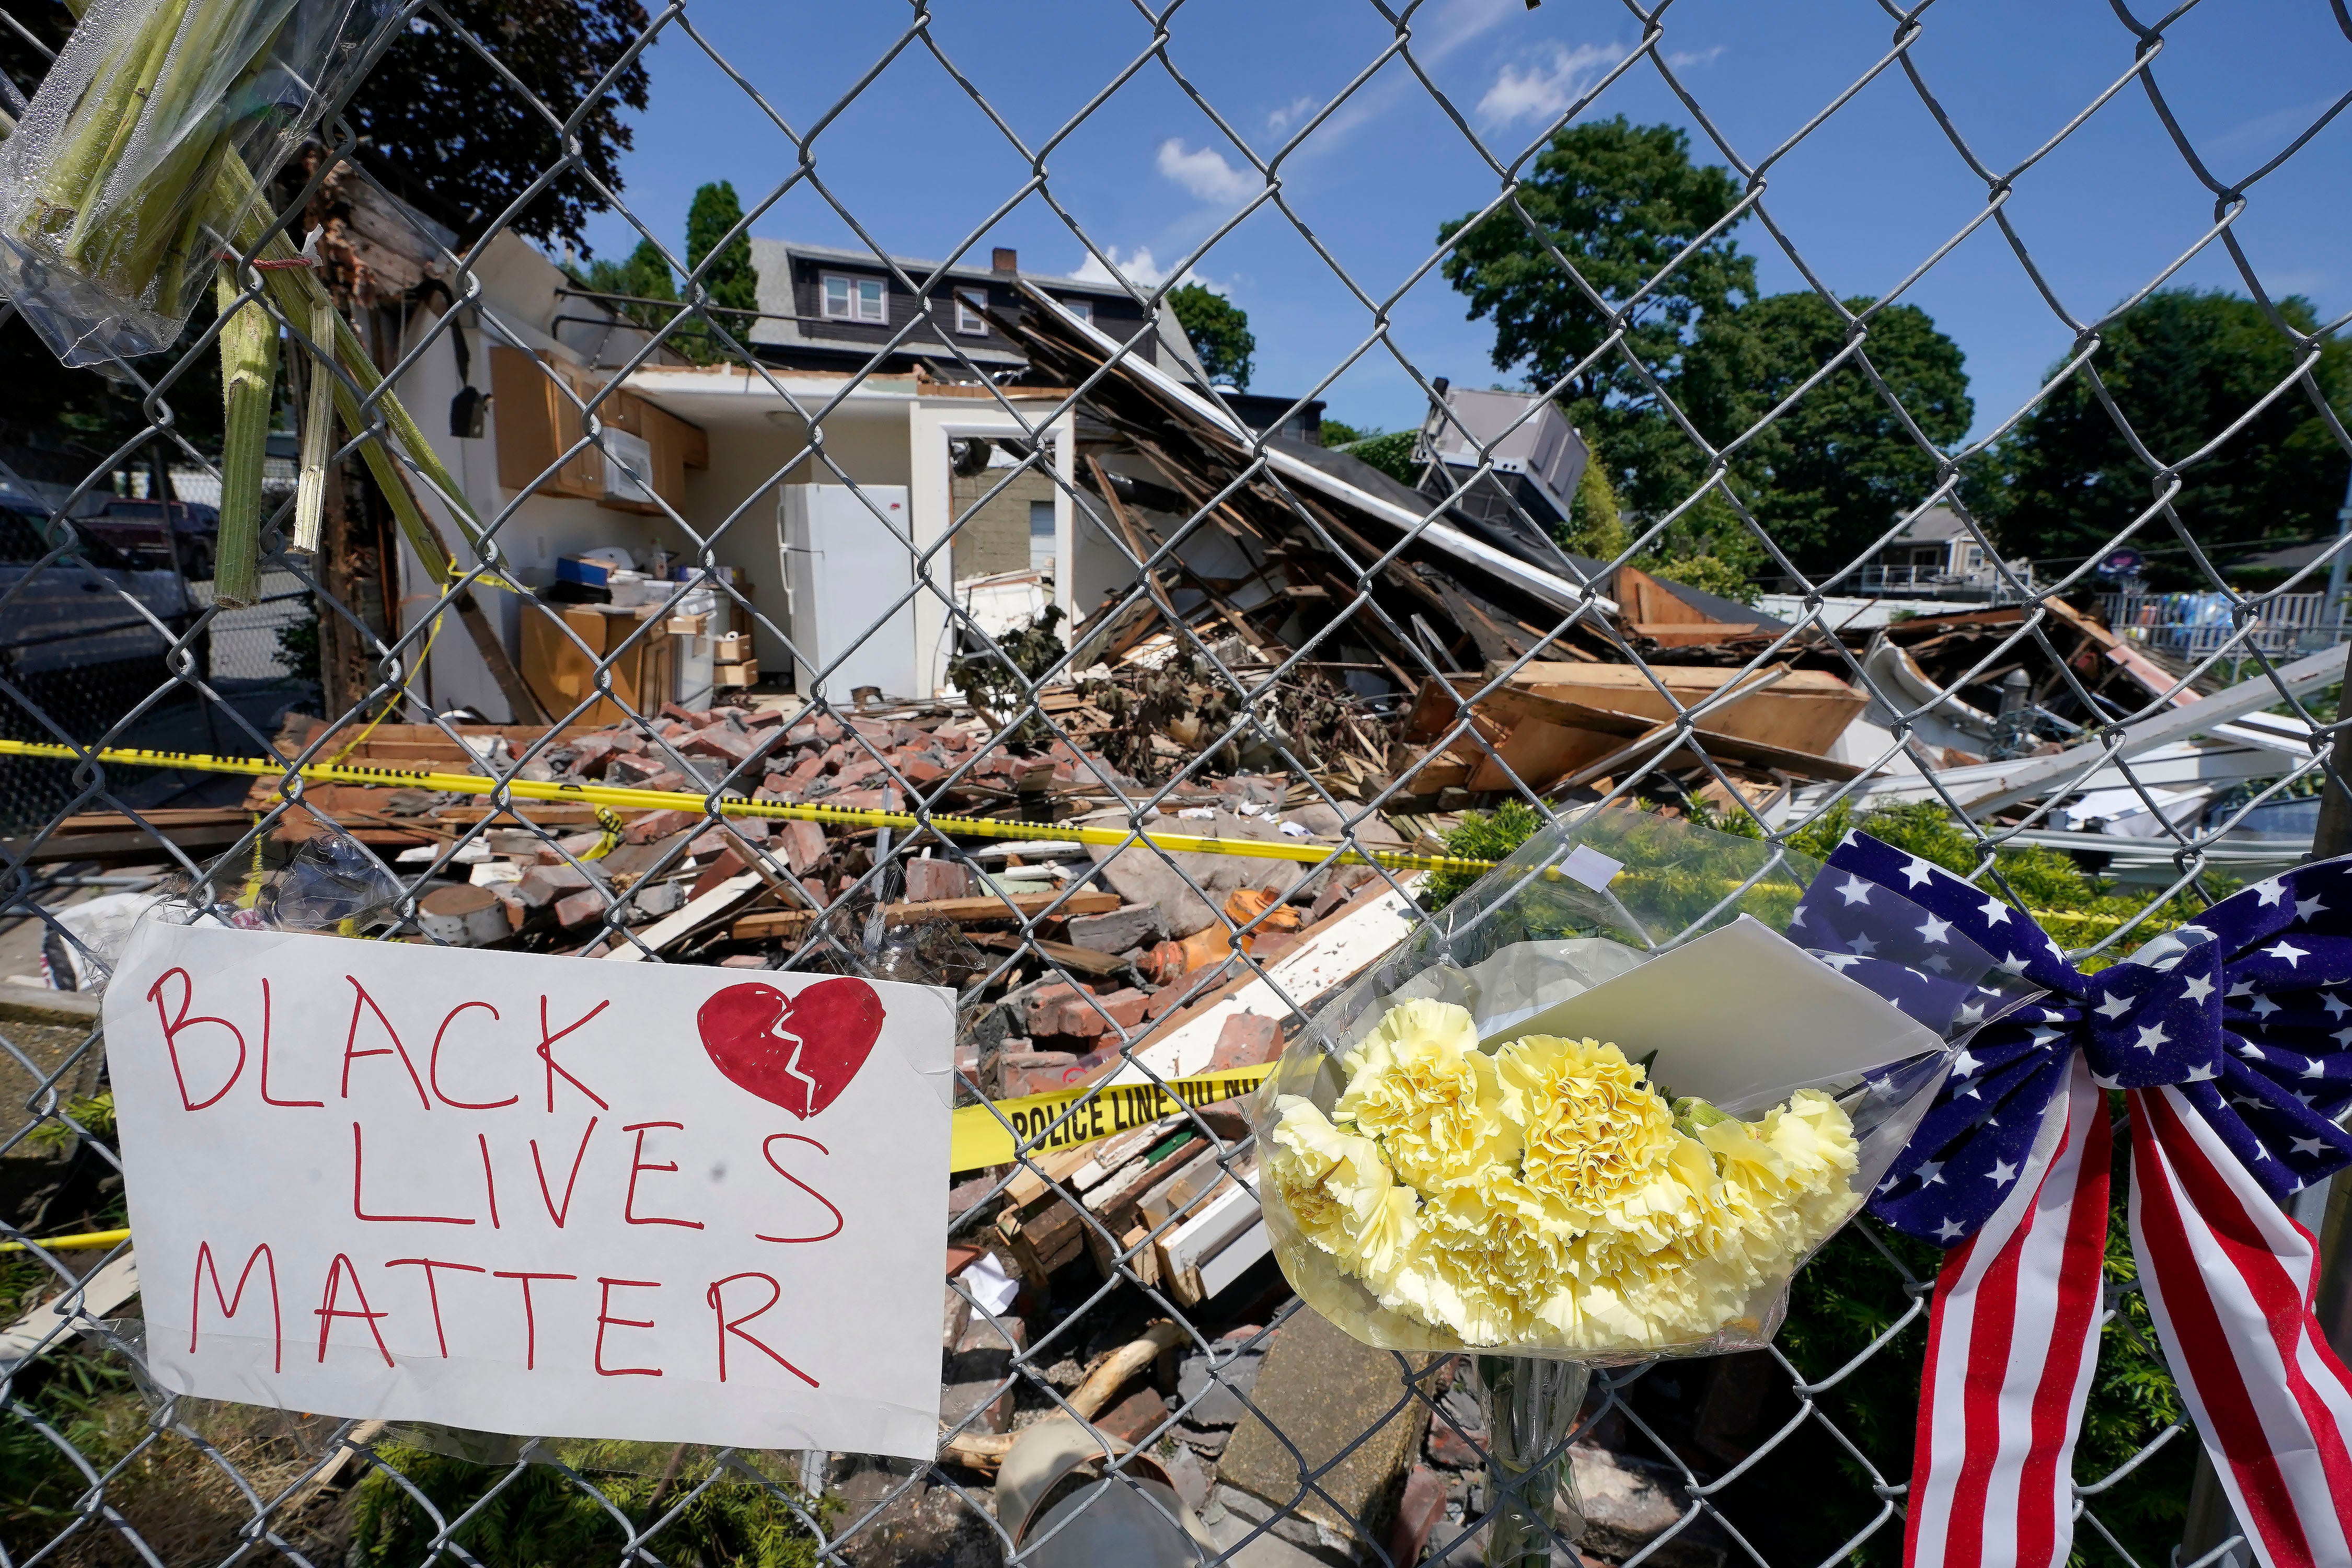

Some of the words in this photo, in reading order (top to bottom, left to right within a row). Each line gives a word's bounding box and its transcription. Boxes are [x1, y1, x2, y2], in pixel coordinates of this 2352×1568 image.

[147, 966, 610, 1113] BLACK
[353, 1115, 844, 1244] LIVES
[1012, 1094, 1105, 1151] POLICE
[1111, 1083, 1170, 1131] LINE
[189, 1241, 820, 1388] MATTER
